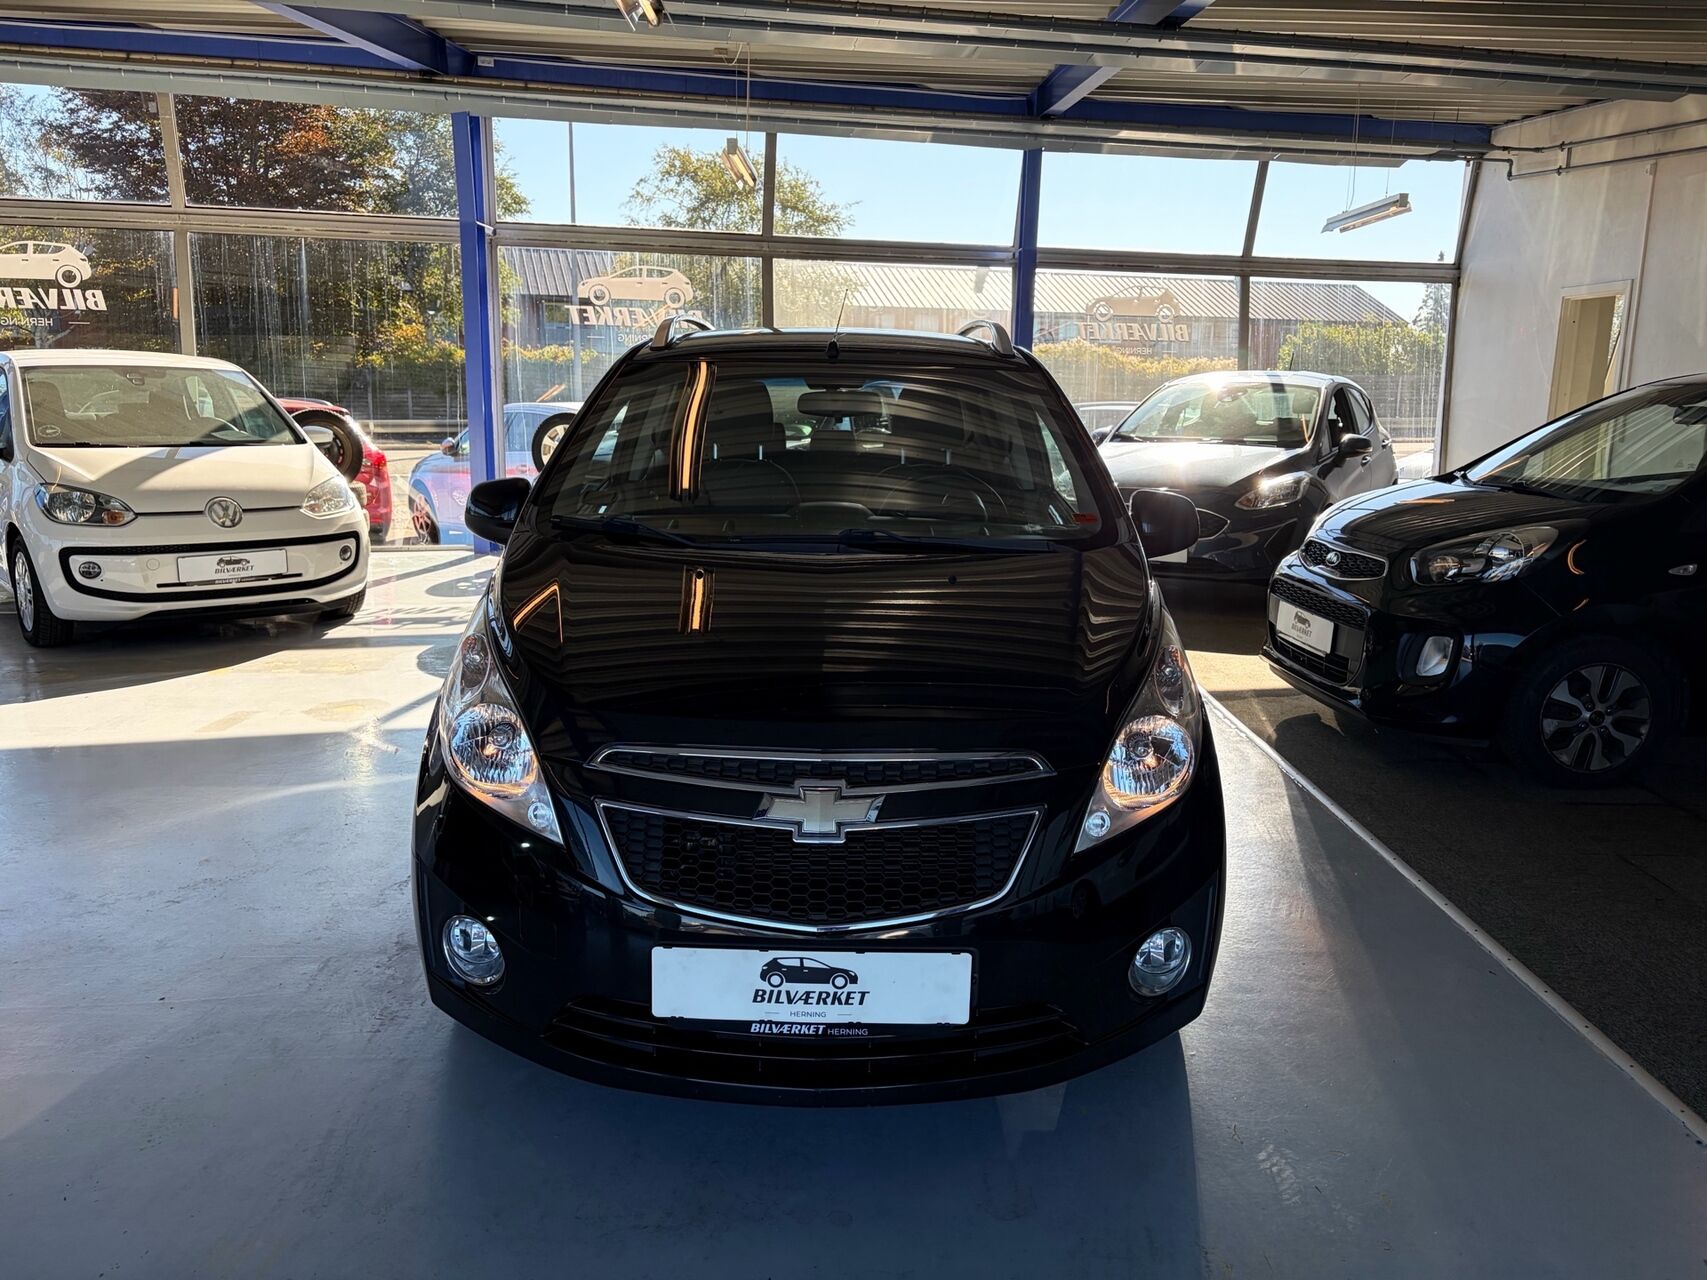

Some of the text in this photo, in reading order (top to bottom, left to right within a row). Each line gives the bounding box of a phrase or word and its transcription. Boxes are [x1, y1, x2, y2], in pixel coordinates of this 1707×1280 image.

[752, 988, 870, 1006] BILVÆRKET
[789, 1010, 827, 1018] HERNING
[750, 1022, 868, 1036] BILVÆRKET HERNING
